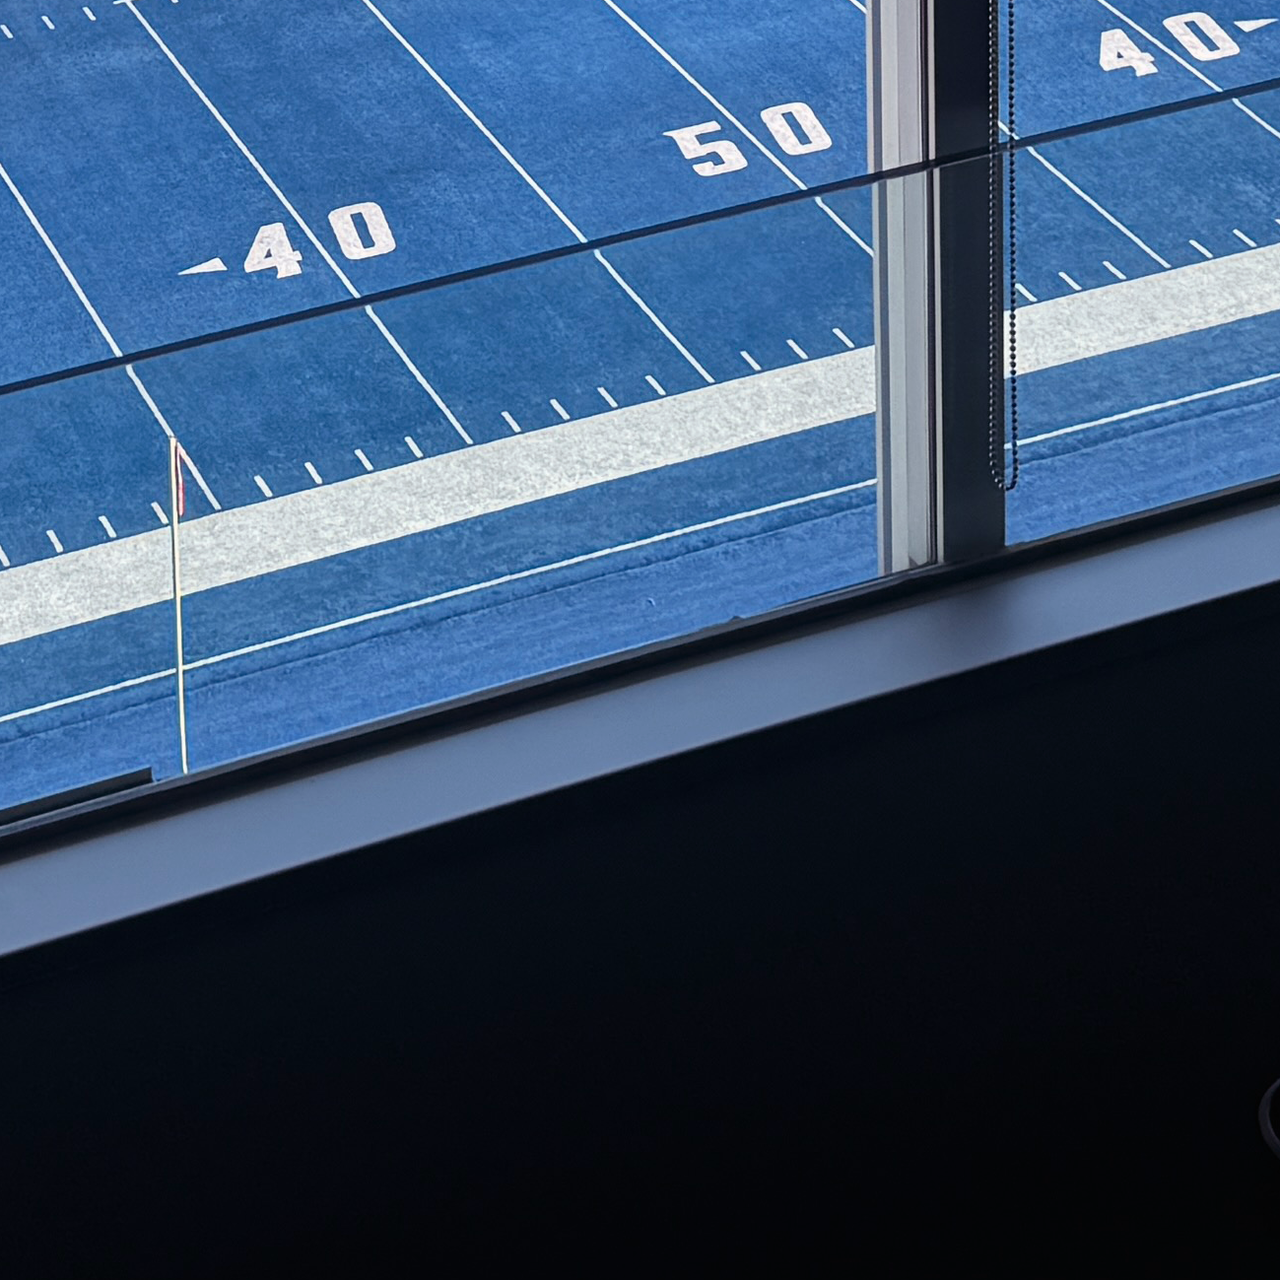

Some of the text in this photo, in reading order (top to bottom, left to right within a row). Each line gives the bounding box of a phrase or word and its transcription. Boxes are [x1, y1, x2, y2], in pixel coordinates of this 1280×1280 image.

[1098, 12, 1239, 78] 40
[664, 102, 833, 177] 50
[242, 202, 396, 279] 40
